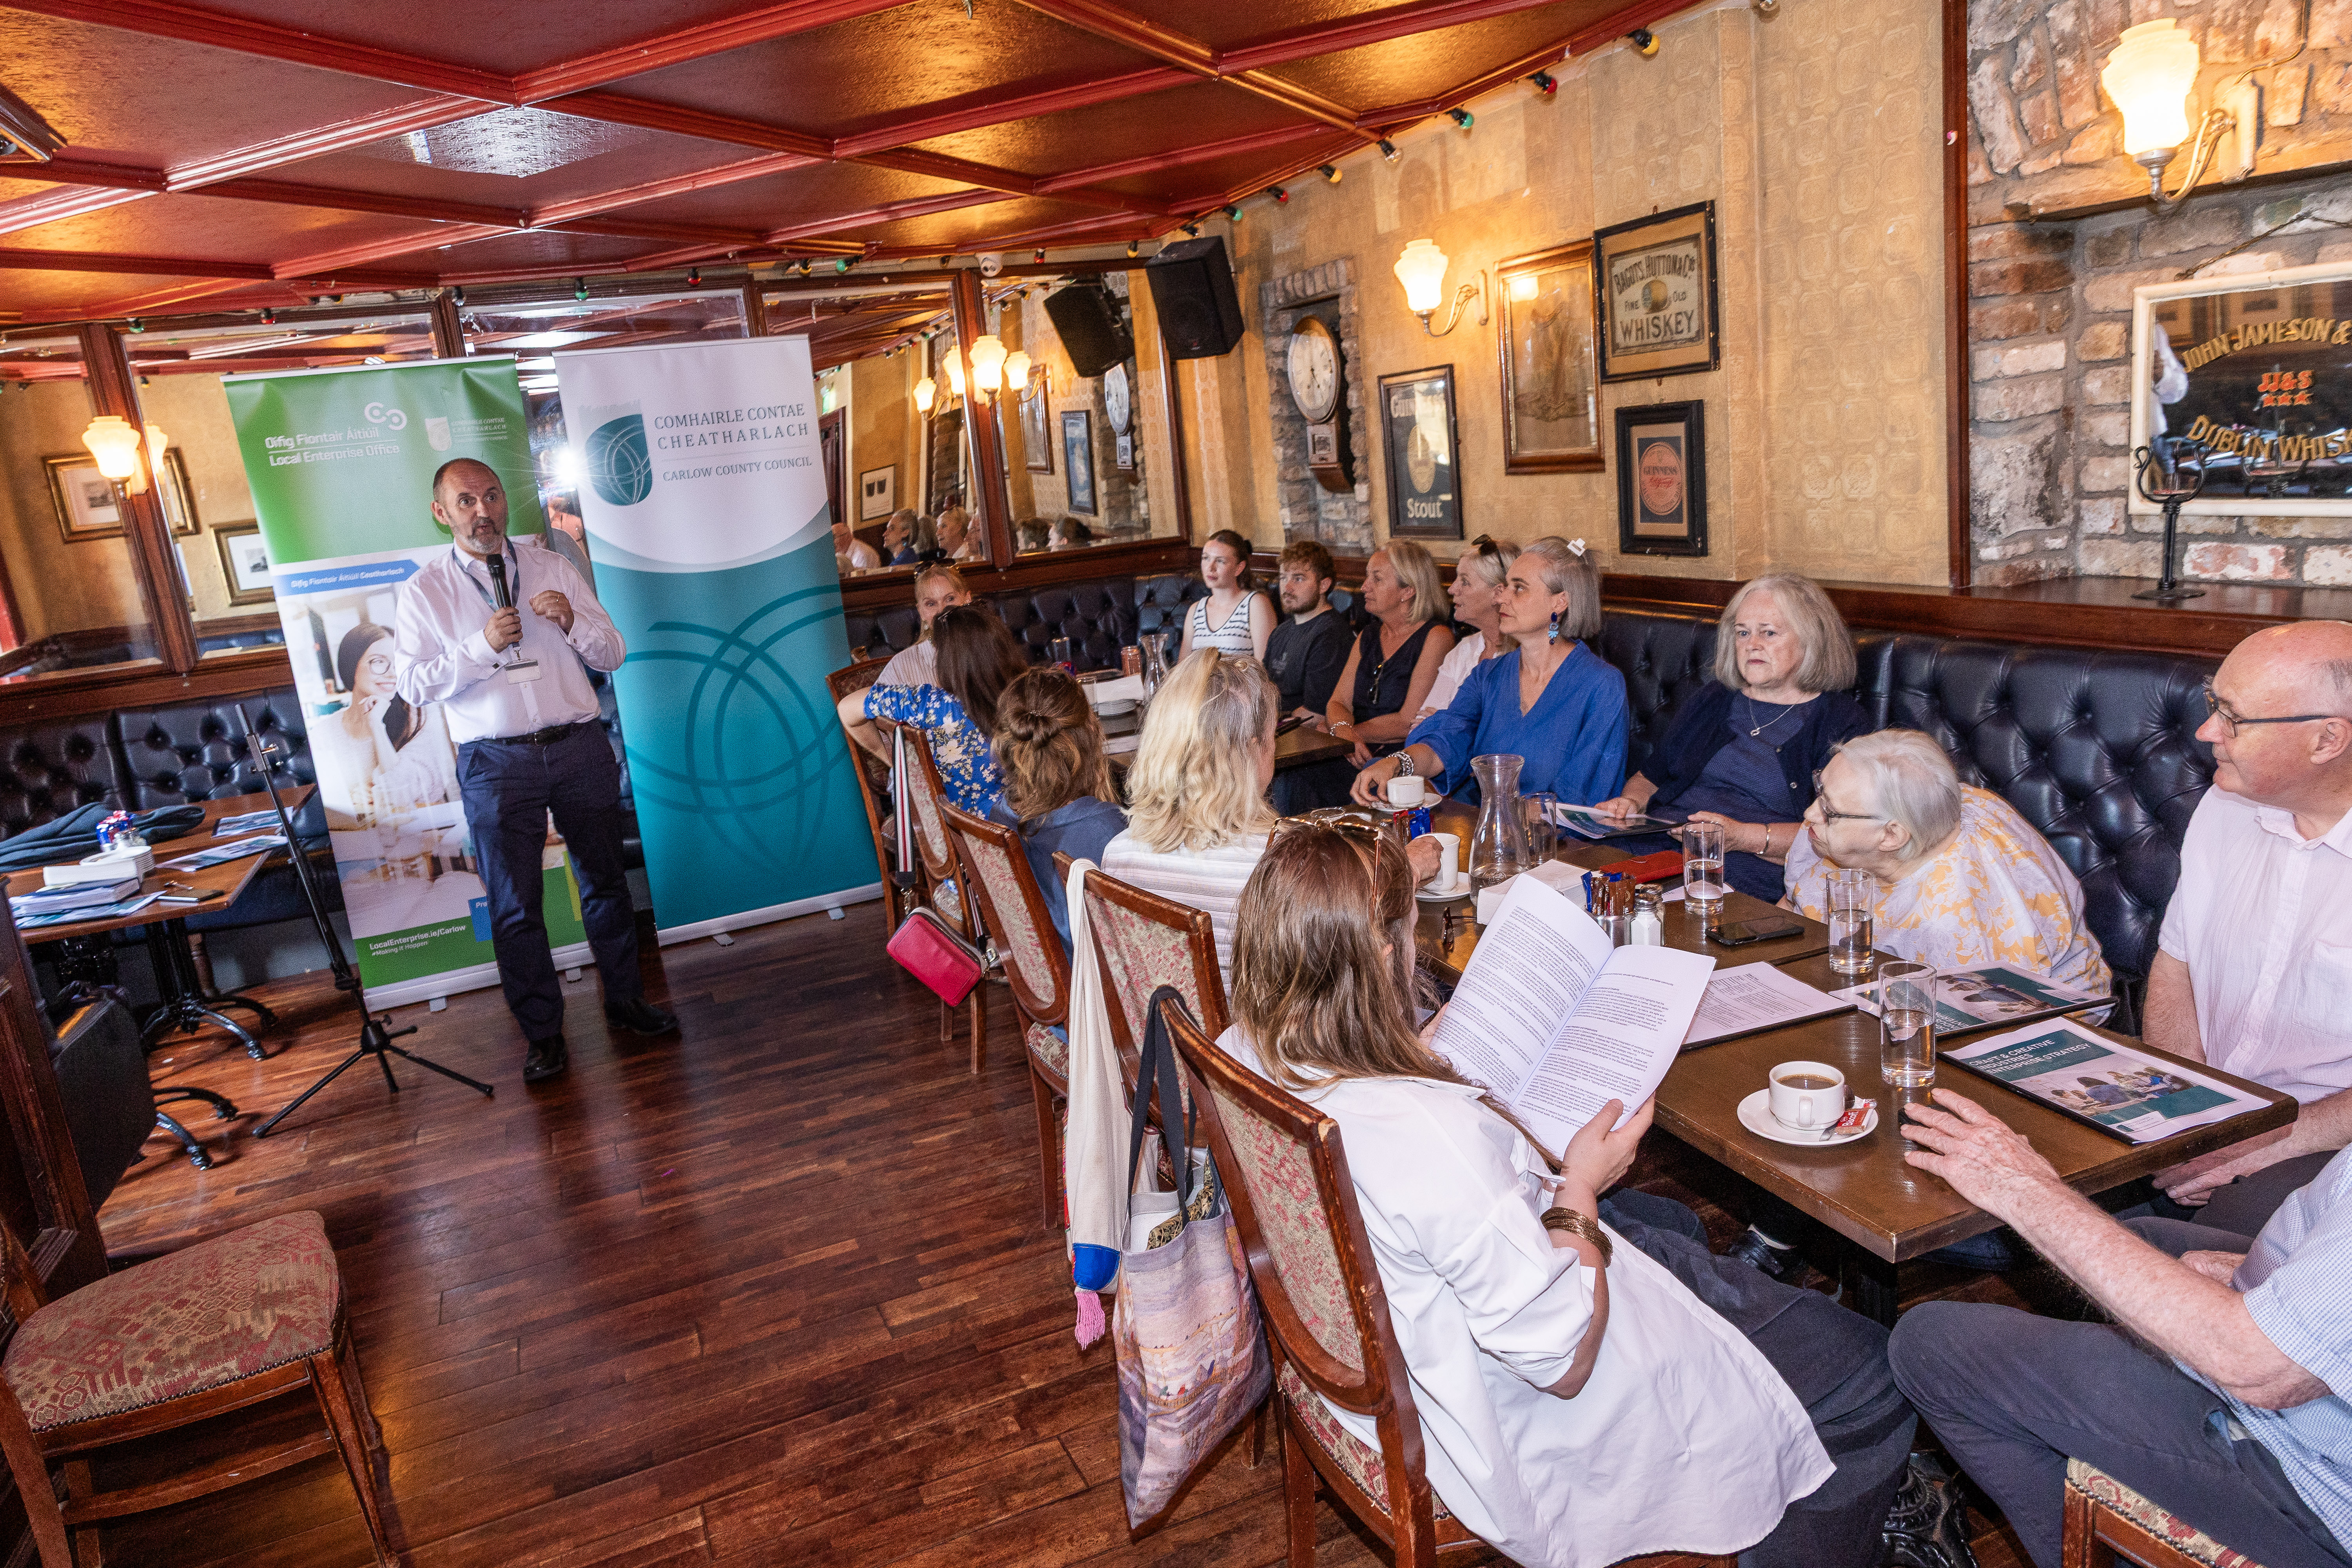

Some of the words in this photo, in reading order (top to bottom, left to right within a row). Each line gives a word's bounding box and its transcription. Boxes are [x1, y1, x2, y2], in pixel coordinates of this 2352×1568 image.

[1625, 300, 1639, 312] FINE
[1673, 291, 1687, 302] OLD
[1620, 310, 1694, 343] WHISKEY
[2182, 332, 2232, 373] JOHN
[2234, 318, 2336, 351] JAMESON
[2331, 320, 2352, 345] &
[2258, 370, 2314, 393] JJ&S
[654, 409, 743, 429] COMHAIRLE
[748, 403, 805, 421] CONTAE
[265, 435, 294, 449] Oifig
[296, 431, 343, 445] Fiontair
[657, 423, 809, 450] CHEATHARLACH
[2187, 415, 2273, 460] DUBLIN
[269, 453, 301, 466] Local
[303, 448, 363, 462] Enterprise
[366, 444, 400, 456] Office
[663, 467, 712, 481] CARLOW
[716, 462, 761, 475] COUNTY
[764, 456, 812, 470] COUNCIL
[1643, 466, 1678, 475] GUINNESS
[1406, 497, 1443, 519] Stout
[291, 579, 308, 588] Oifig
[309, 576, 337, 586] Fiontair
[370, 925, 466, 950] LocalEnterprise.ie/Carlow
[405, 941, 428, 950] Happen
[1969, 1056, 2001, 1066] CRAFT
[2009, 1040, 2055, 1056] CREATIVE
[1978, 1053, 2034, 1071] INDUSTRIES
[1987, 1057, 2045, 1074] ENTERPRISE
[2044, 1043, 2092, 1059] STRATEGY
[1842, 1111, 1859, 1127] Biscoff
